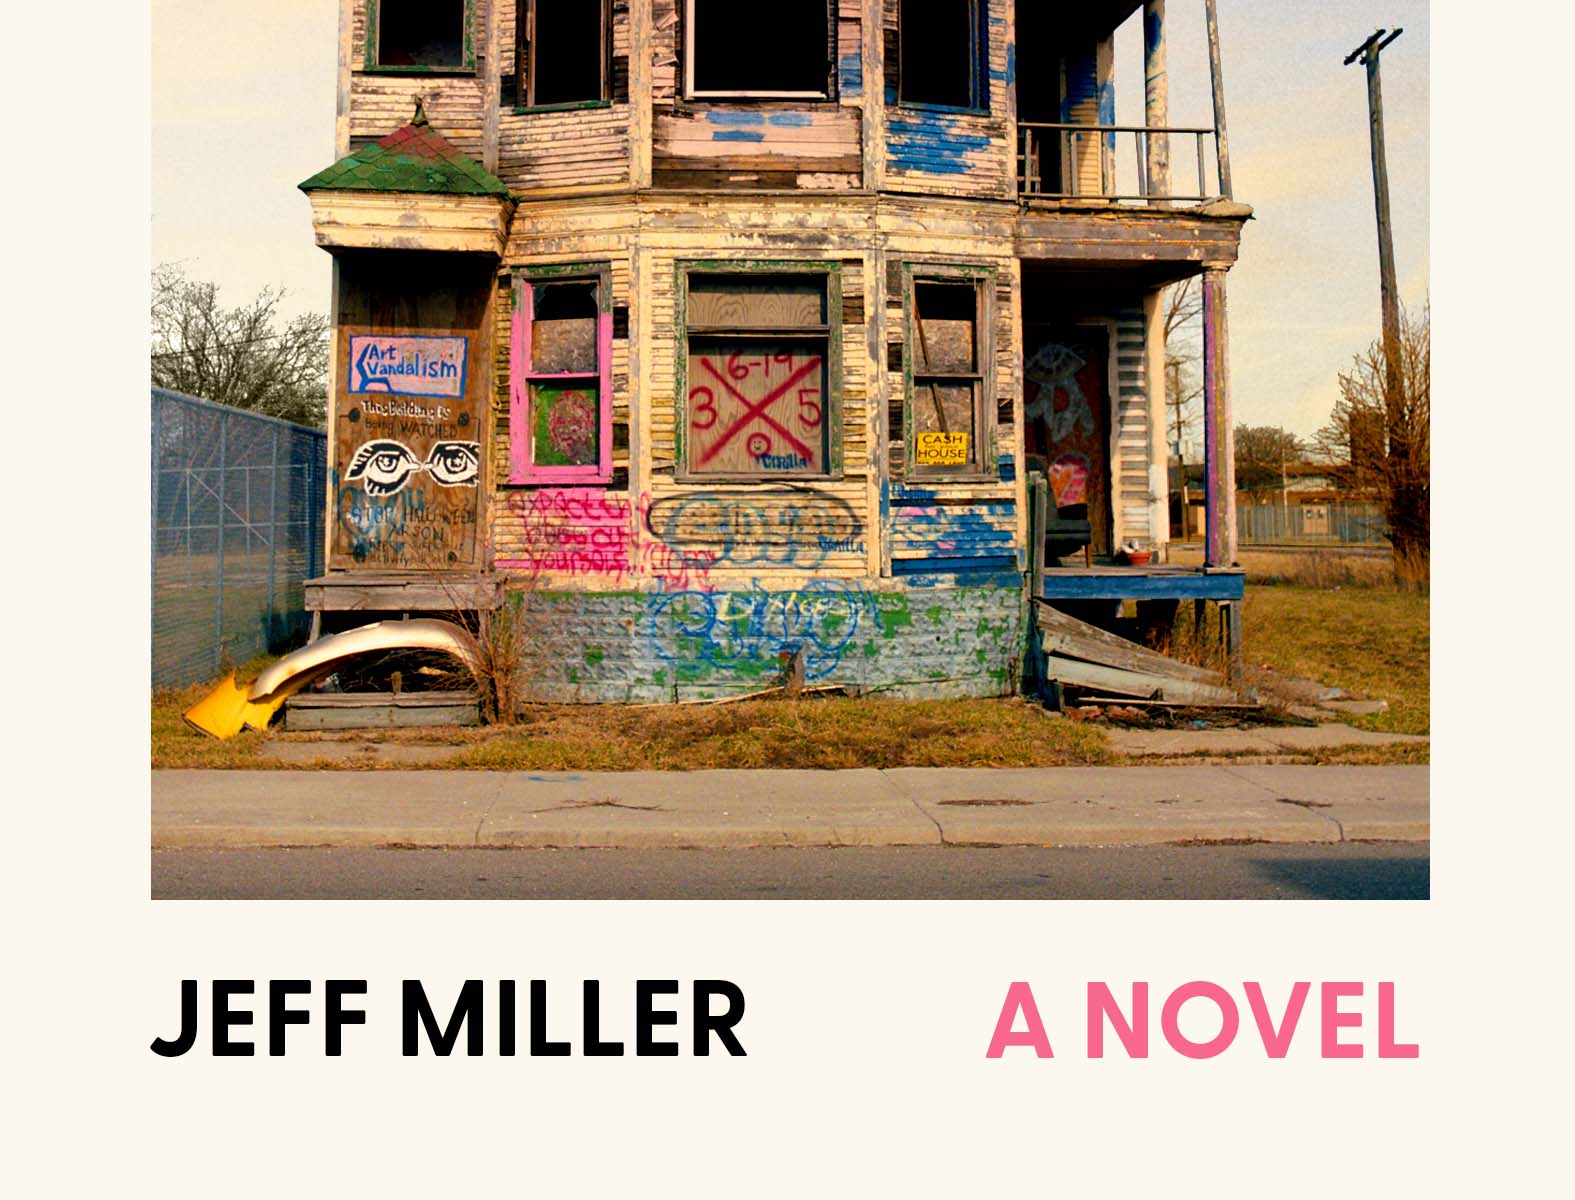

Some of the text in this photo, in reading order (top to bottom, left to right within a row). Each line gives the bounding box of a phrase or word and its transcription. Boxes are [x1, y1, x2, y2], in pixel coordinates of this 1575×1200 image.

[368, 343, 396, 360] Art
[367, 353, 458, 377] Vandalism
[728, 351, 793, 380] 6-19
[689, 385, 718, 429] 3
[798, 389, 822, 427] 5
[400, 422, 459, 439] WATCHED
[922, 434, 963, 444] CASH
[918, 448, 965, 458] HOUSE
